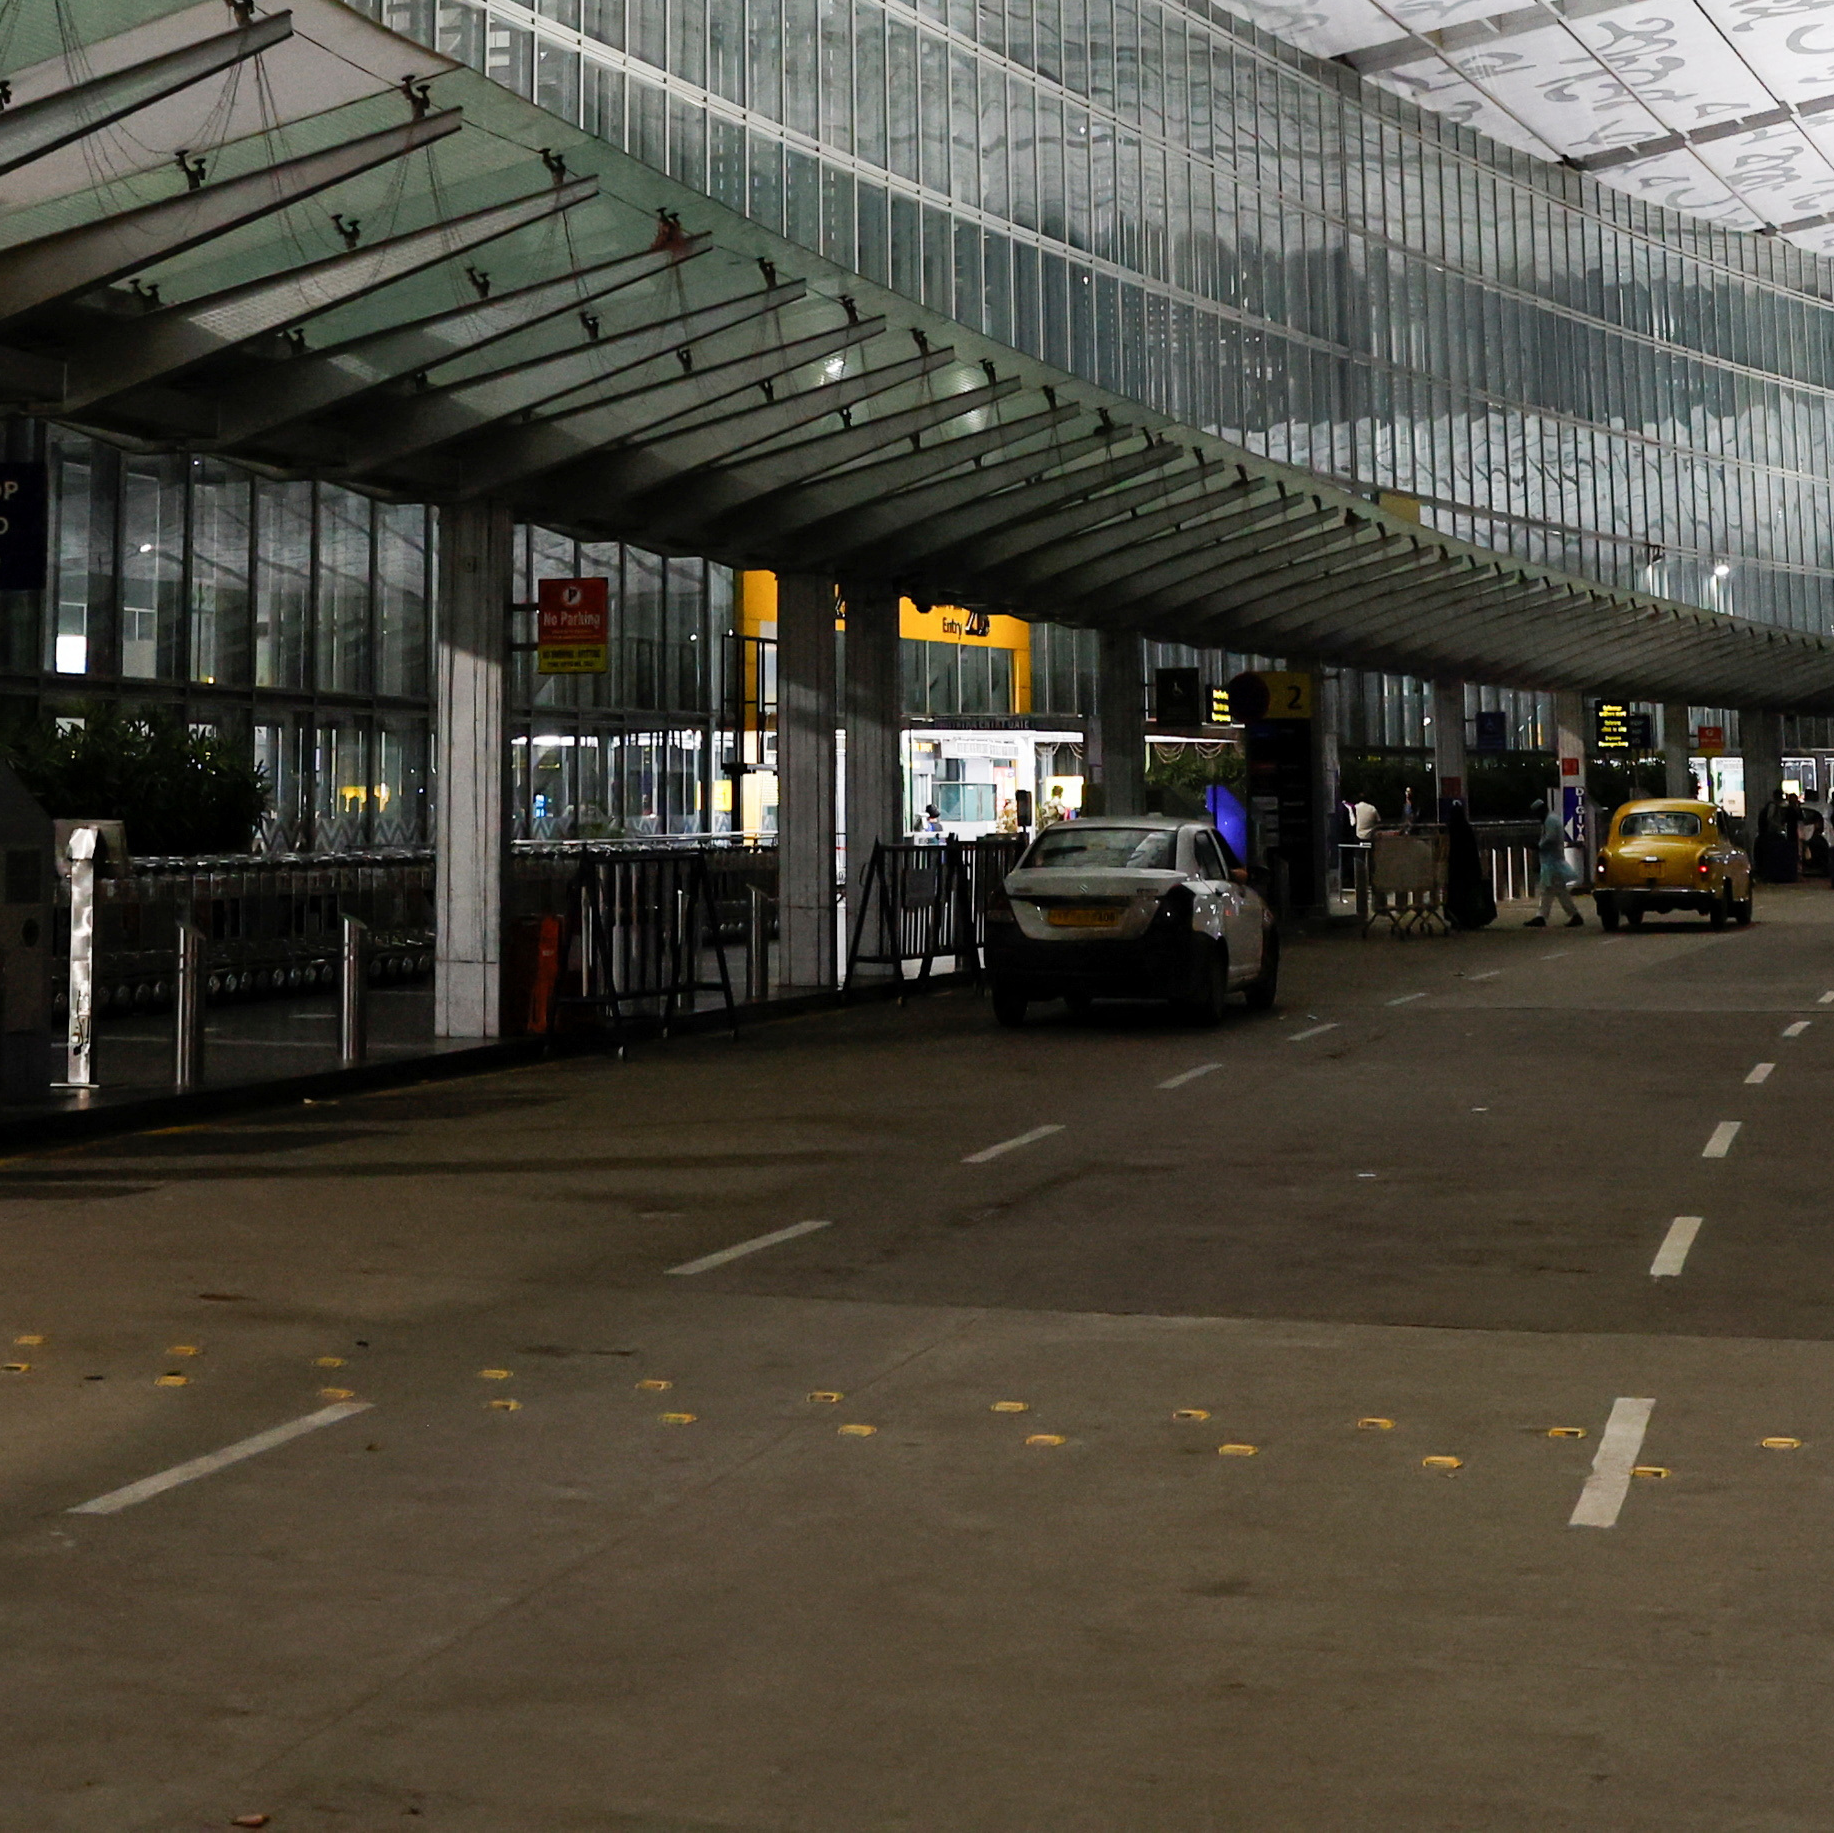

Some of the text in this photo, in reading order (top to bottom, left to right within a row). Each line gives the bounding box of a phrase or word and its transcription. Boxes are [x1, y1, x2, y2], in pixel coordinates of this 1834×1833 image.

[543, 610, 601, 630] No Parking
[942, 616, 962, 641] Entry
[1288, 686, 1302, 710] 2
